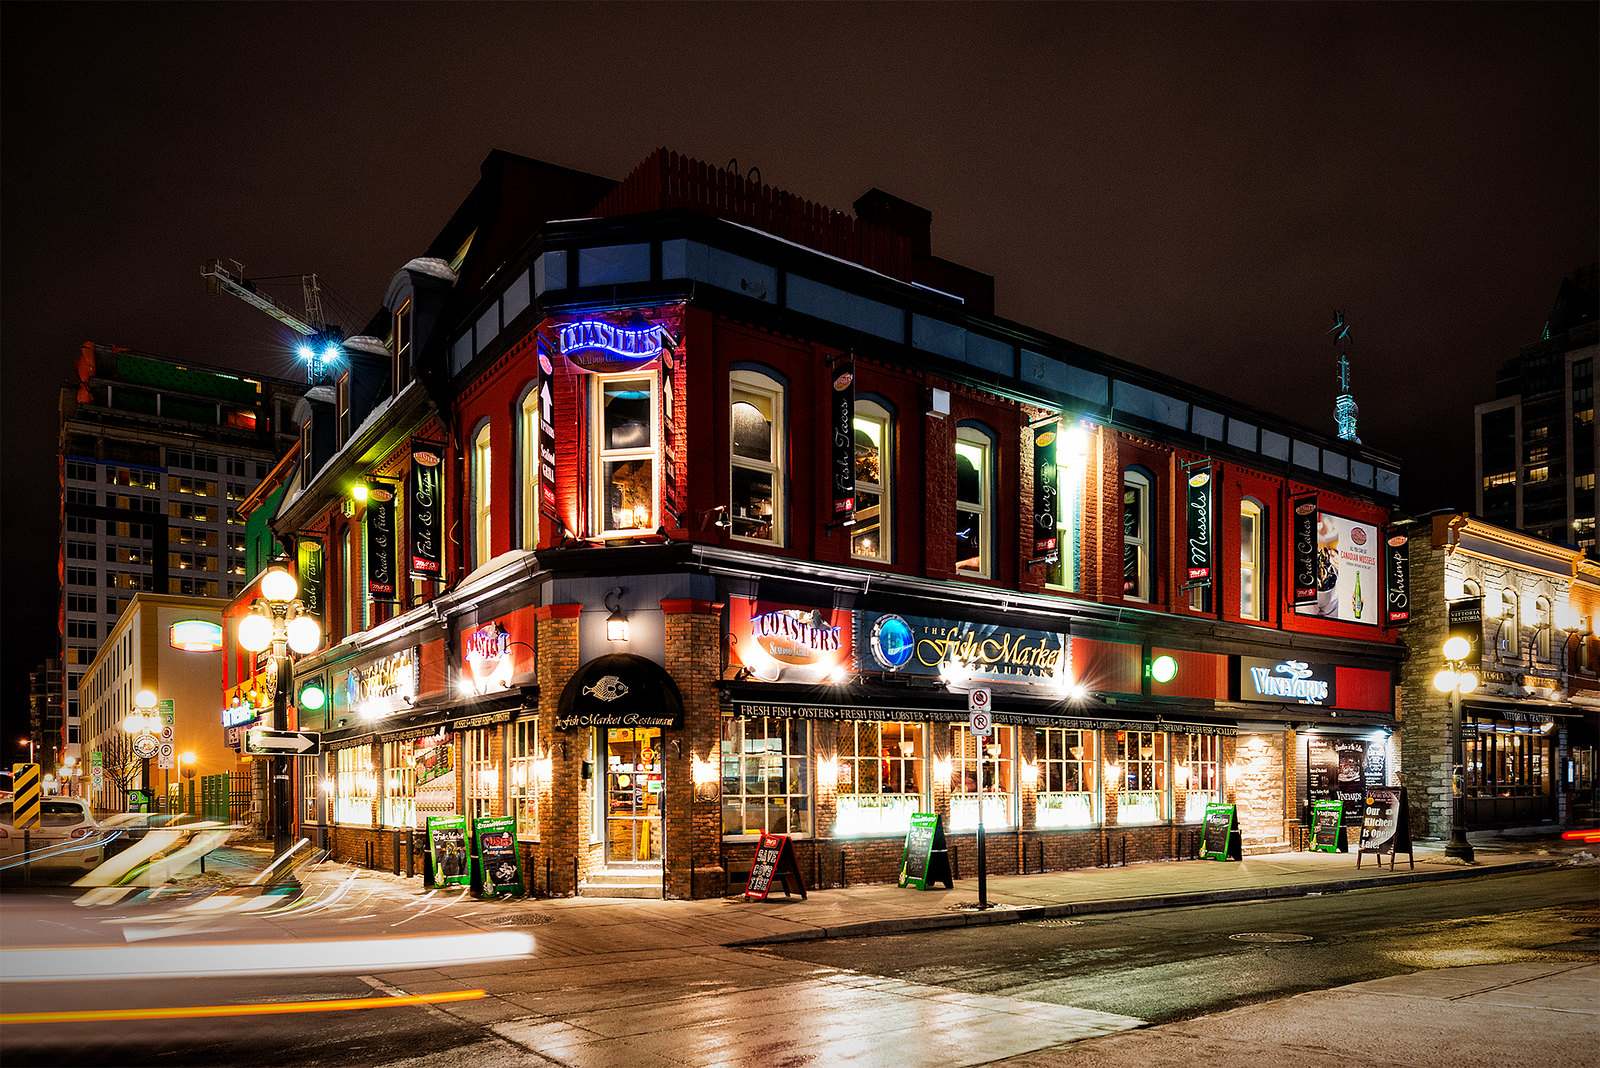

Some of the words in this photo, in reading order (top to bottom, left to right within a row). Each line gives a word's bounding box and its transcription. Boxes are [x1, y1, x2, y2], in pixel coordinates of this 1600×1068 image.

[835, 397, 850, 448] Tacos
[416, 469, 435, 507] Chips
[1189, 491, 1208, 565] Mussels
[1298, 519, 1313, 554] Cakes
[417, 529, 436, 558] Fish
[375, 551, 389, 584] Steak
[1300, 557, 1314, 586] Crab
[1389, 550, 1408, 608] Shrimp
[760, 612, 840, 652] COASTERS
[924, 626, 946, 636] THE
[1250, 667, 1328, 703] VINEYARDS
[580, 713, 621, 726] Market
[623, 712, 674, 726] Restaurant
[741, 705, 770, 716] FRESH
[772, 706, 791, 717] FISH
[798, 707, 834, 718] OYSTERS
[840, 709, 867, 719] FRESH
[868, 710, 885, 720] FISH
[891, 711, 925, 721] LOBSTER
[930, 712, 954, 722] FRESH
[991, 714, 1008, 723] RESH
[1009, 715, 1023, 724] FISH
[1027, 716, 1055, 726] MUSSELS
[1059, 719, 1078, 728] FRESH
[1079, 720, 1093, 728] FISH
[1186, 725, 1202, 733] FRESH
[1203, 726, 1213, 734] FISH
[1503, 711, 1527, 722] VITTORIA
[1364, 817, 1393, 827] Kitchen
[1366, 806, 1381, 816] Our
[1371, 828, 1391, 838] Open
[757, 849, 779, 863] SAVE
